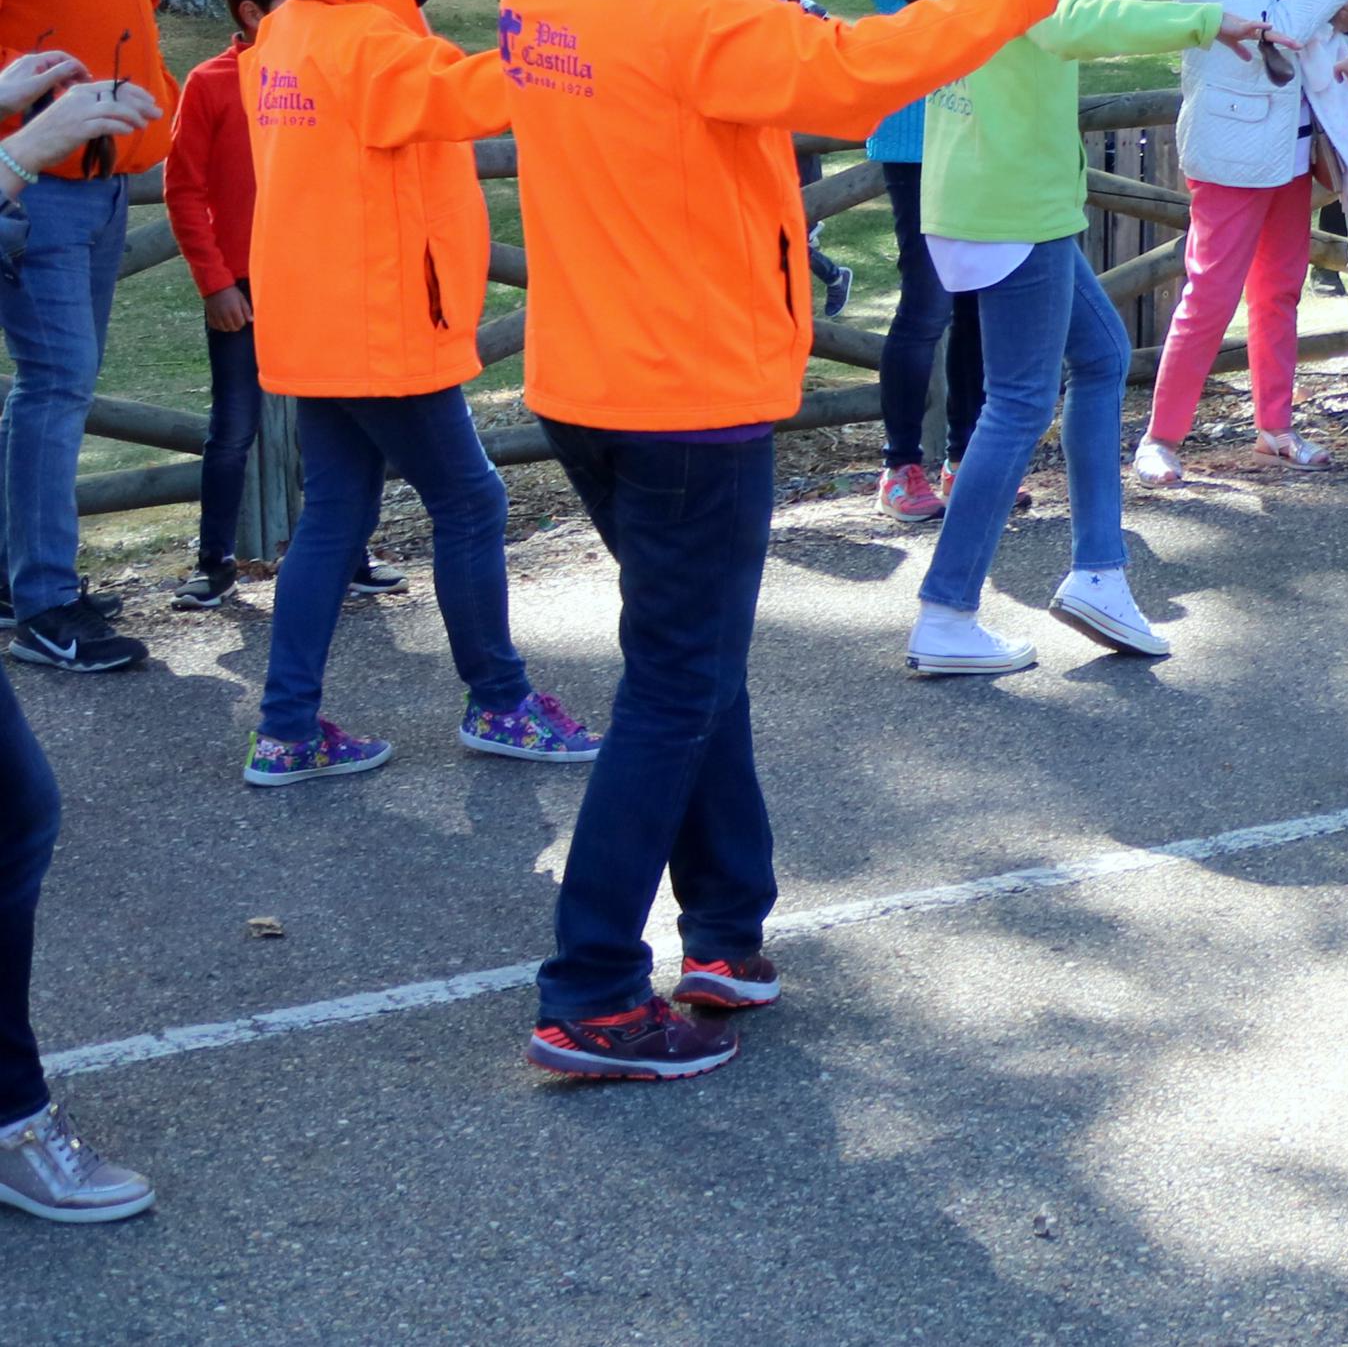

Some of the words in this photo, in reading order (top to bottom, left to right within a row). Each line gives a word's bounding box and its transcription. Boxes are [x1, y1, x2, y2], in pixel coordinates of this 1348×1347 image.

[534, 20, 577, 50] Peña
[521, 44, 593, 80] Castilla
[561, 81, 595, 98] 1978
